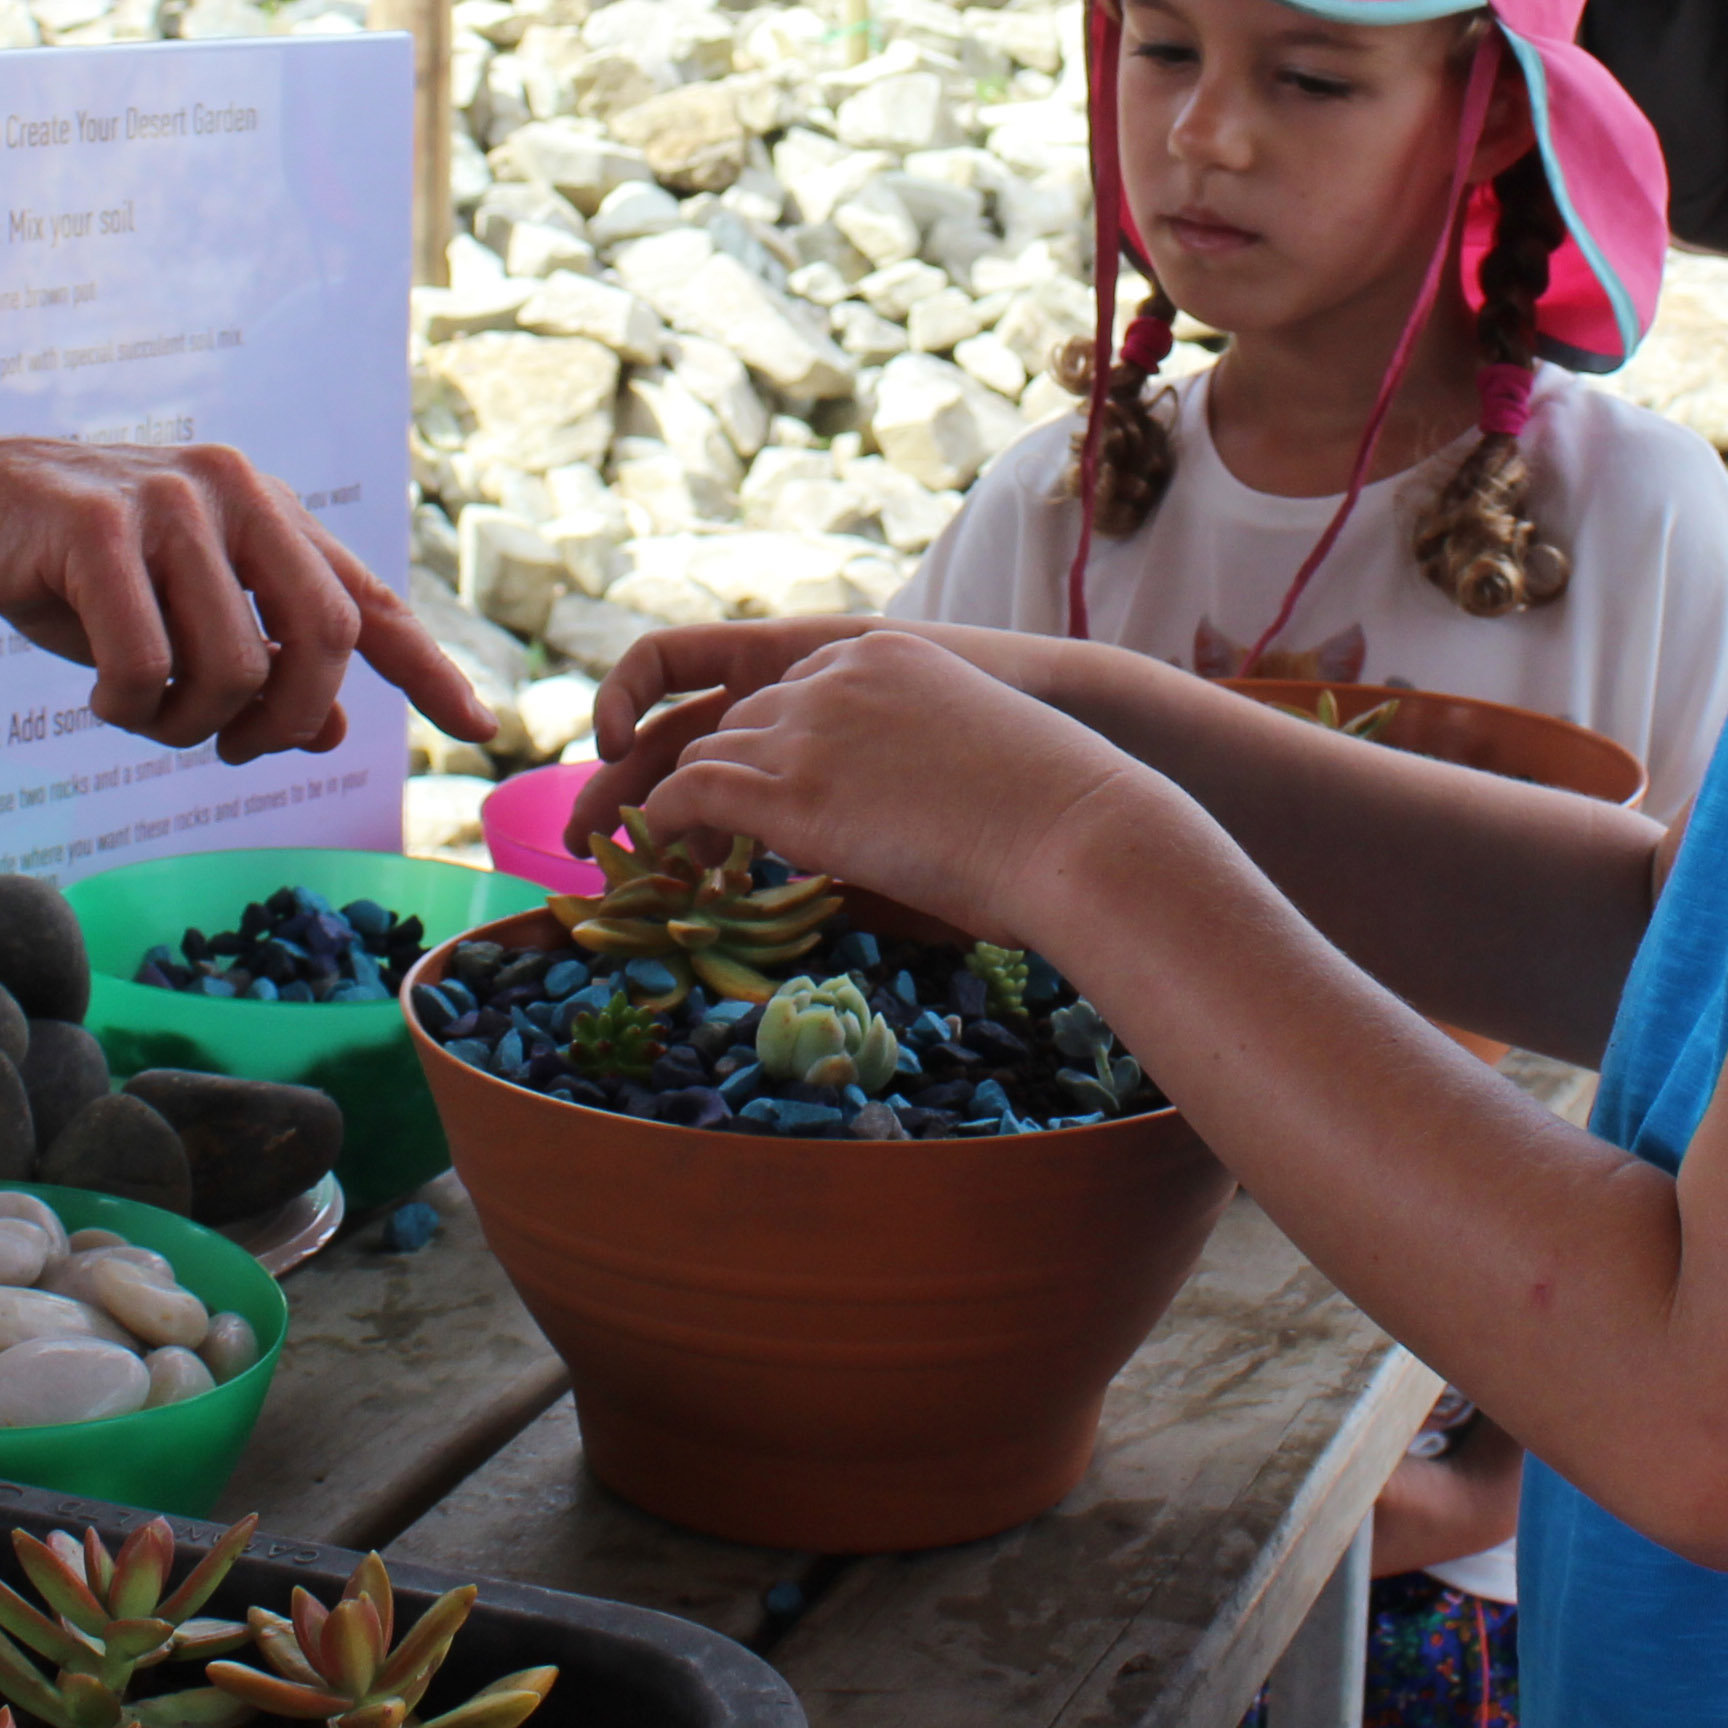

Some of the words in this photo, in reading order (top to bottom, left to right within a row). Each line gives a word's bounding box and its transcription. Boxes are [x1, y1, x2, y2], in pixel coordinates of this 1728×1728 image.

[6, 114, 70, 149] Create
[76, 109, 119, 143] Your
[126, 106, 187, 139] Desert
[193, 102, 258, 135] Garden
[8, 207, 44, 243] Mix
[49, 210, 92, 248] your
[99, 199, 136, 236] soil
[24, 284, 69, 309] brown
[73, 281, 98, 308] pot
[0, 353, 23, 379] pot
[28, 347, 59, 372] with
[63, 340, 114, 370] special
[117, 332, 186, 361] succulent
[189, 328, 215, 352] soil
[7, 706, 47, 746] Add
[19, 784, 46, 809] two
[50, 773, 90, 802] rocks
[93, 764, 120, 791] and
[123, 766, 133, 784] a
[135, 752, 172, 781] small
[20, 844, 64, 871] where
[67, 838, 94, 867] you
[97, 825, 132, 852] want
[135, 817, 170, 843] these
[174, 803, 211, 831] rocks
[215, 794, 240, 822] and
[244, 788, 289, 815] stones
[291, 783, 305, 804] to
[307, 777, 322, 799] be
[326, 774, 339, 794] in
[341, 769, 369, 797] your
